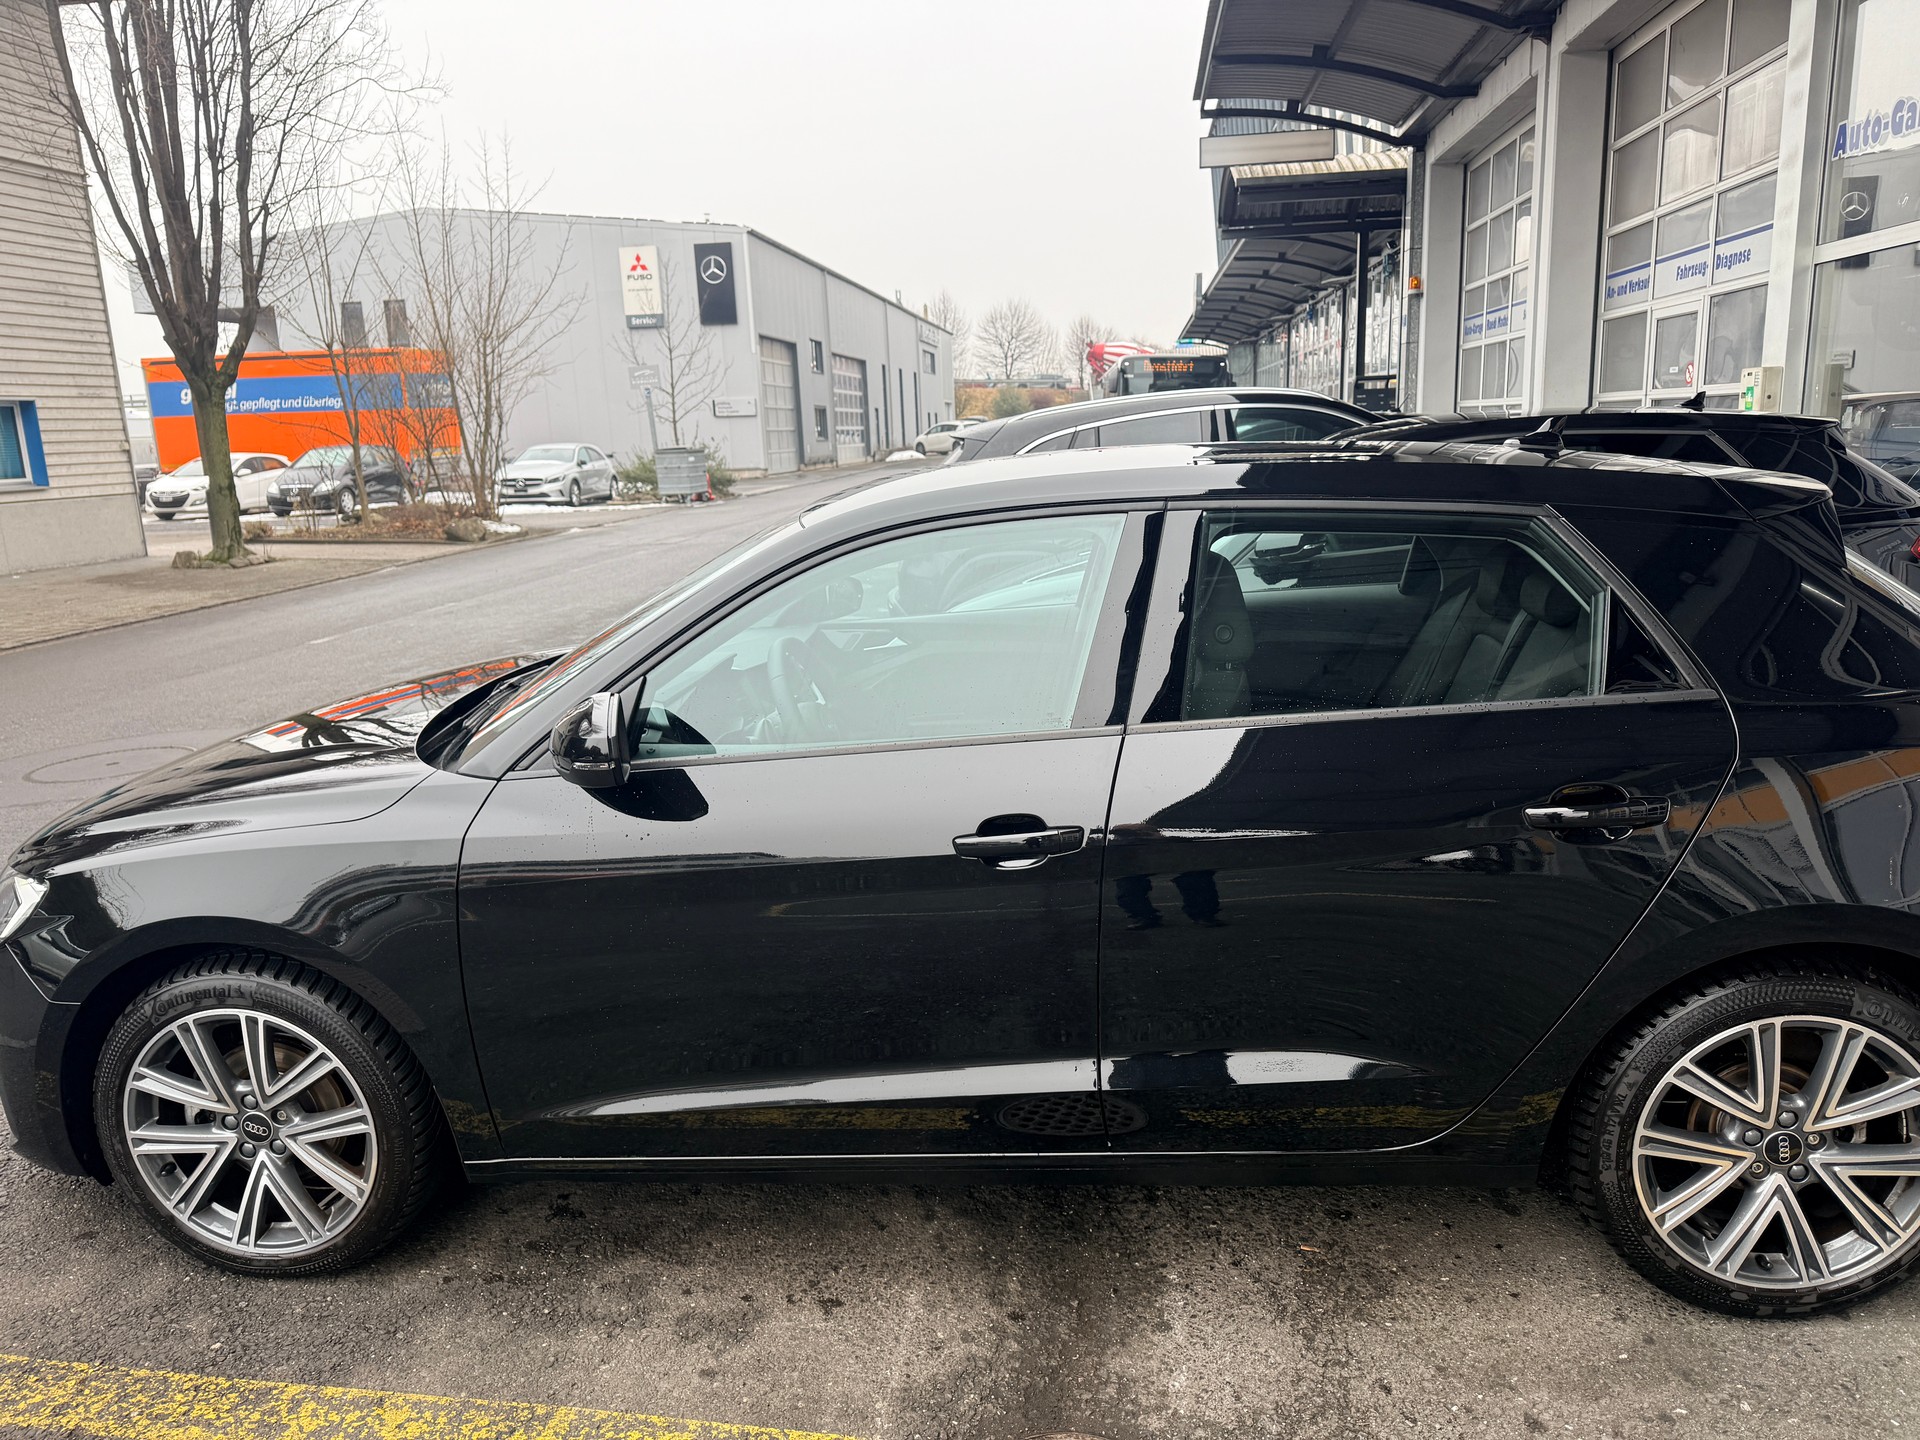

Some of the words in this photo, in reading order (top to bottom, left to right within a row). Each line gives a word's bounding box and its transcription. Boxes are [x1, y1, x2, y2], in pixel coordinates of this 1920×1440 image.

[1832, 98, 1920, 160] Auto-Ga
[627, 273, 653, 281] FUSO
[1675, 260, 1709, 281] Fahrzeug-
[1715, 248, 1751, 270] Diagnose
[1606, 285, 1616, 299] An-
[1617, 281, 1628, 296] und
[1629, 274, 1650, 293] Verkauf
[240, 397, 280, 412] gepflegt
[281, 396, 301, 408] und
[303, 395, 343, 409] überleg
[153, 984, 232, 1017] Continental
